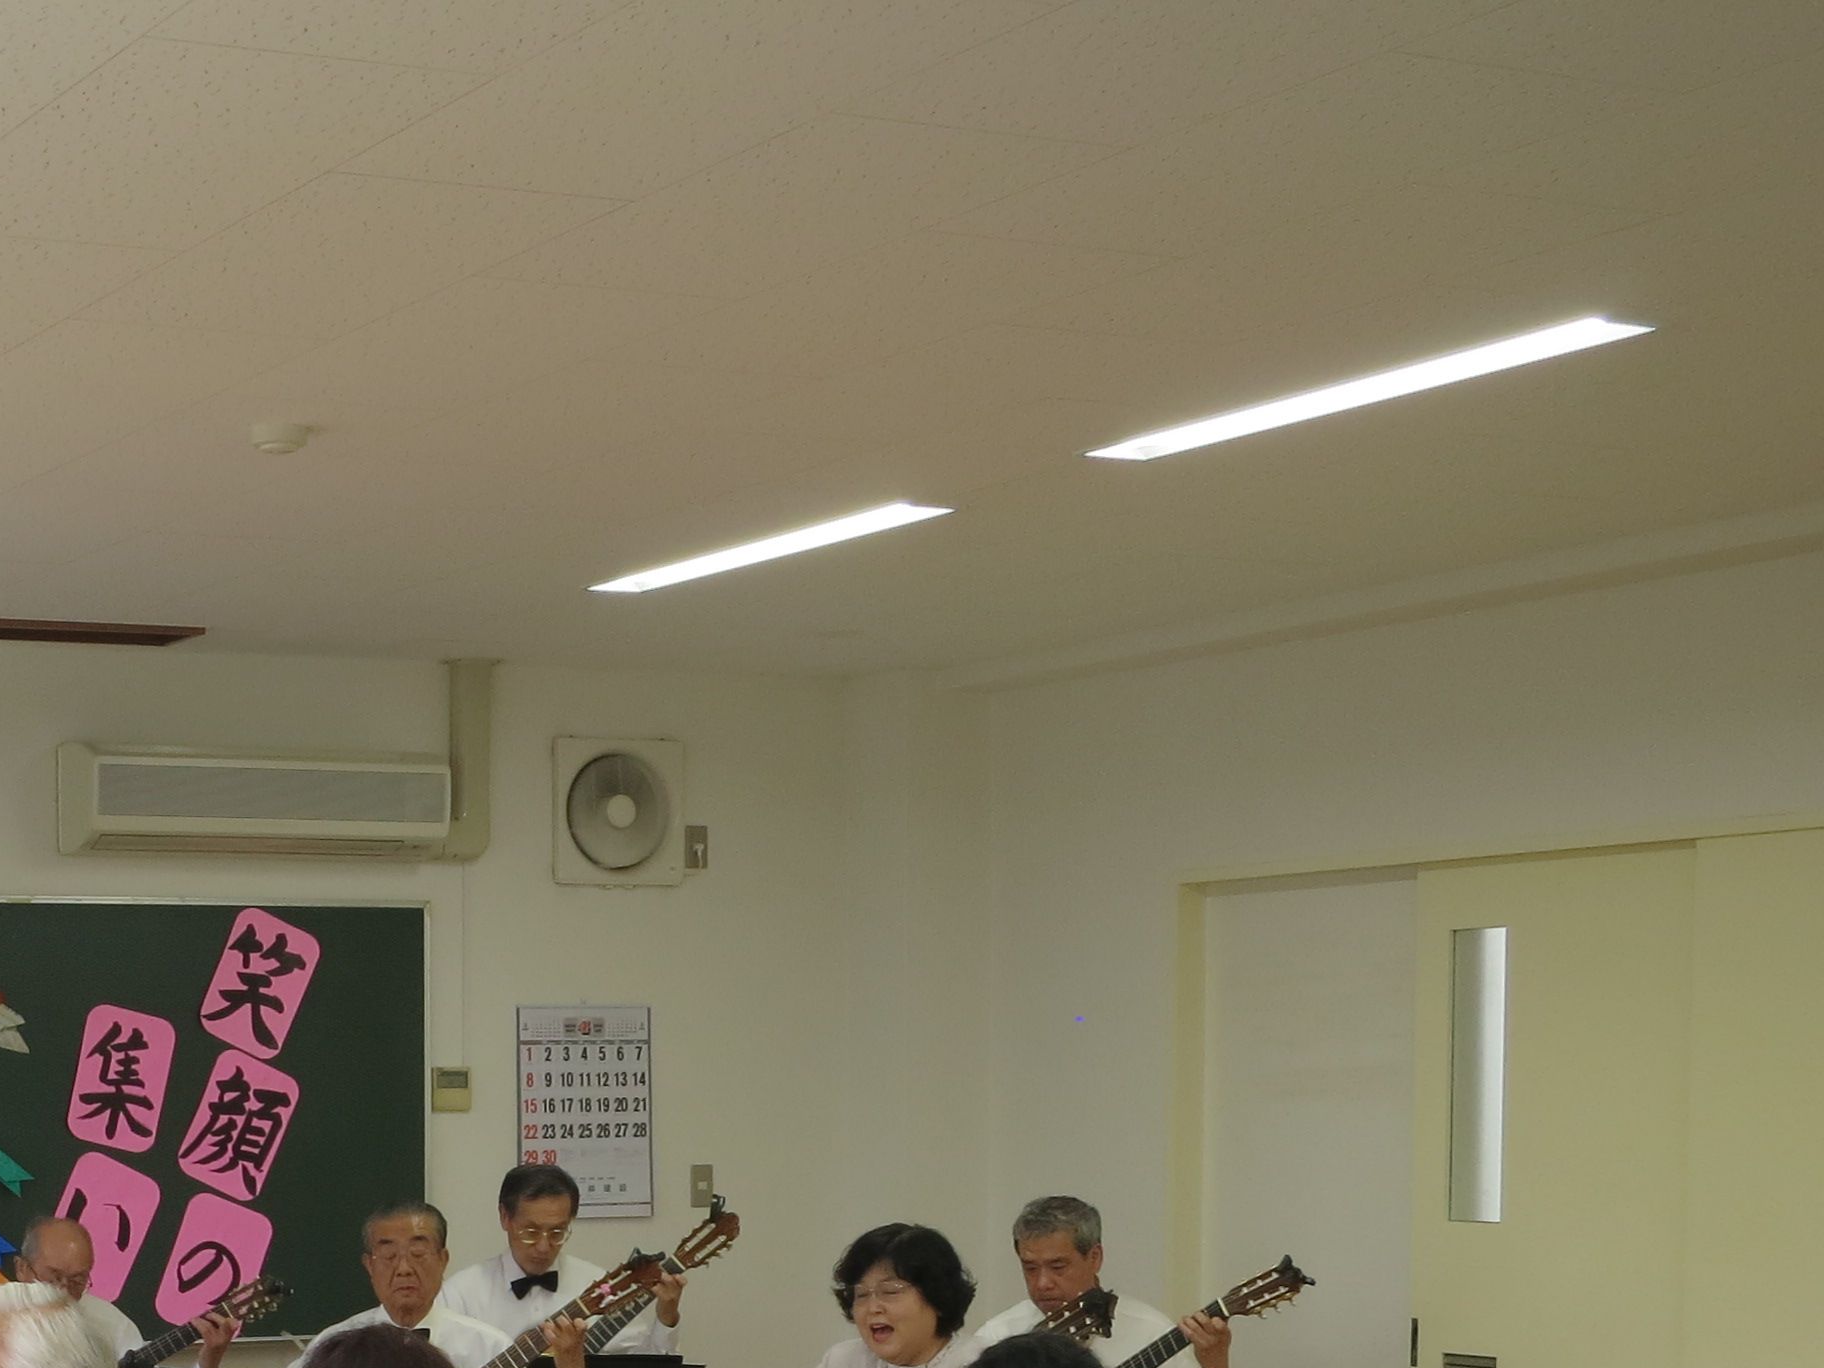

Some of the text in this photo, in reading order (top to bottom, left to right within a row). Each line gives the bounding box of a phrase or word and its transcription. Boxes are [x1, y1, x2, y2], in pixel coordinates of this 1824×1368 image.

[527, 1046, 642, 1061] 1 2 3 4 5 6 7
[526, 1071, 646, 1087] 8 9 10 11 12 13 14
[524, 1097, 646, 1113] 15 16 17 18 19 20 21
[178, 924, 307, 1306] 笑顔の
[66, 1021, 164, 1251] 集い
[523, 1122, 647, 1139] 22 23 24 25 26 27 28
[524, 1149, 556, 1165] 29 30
